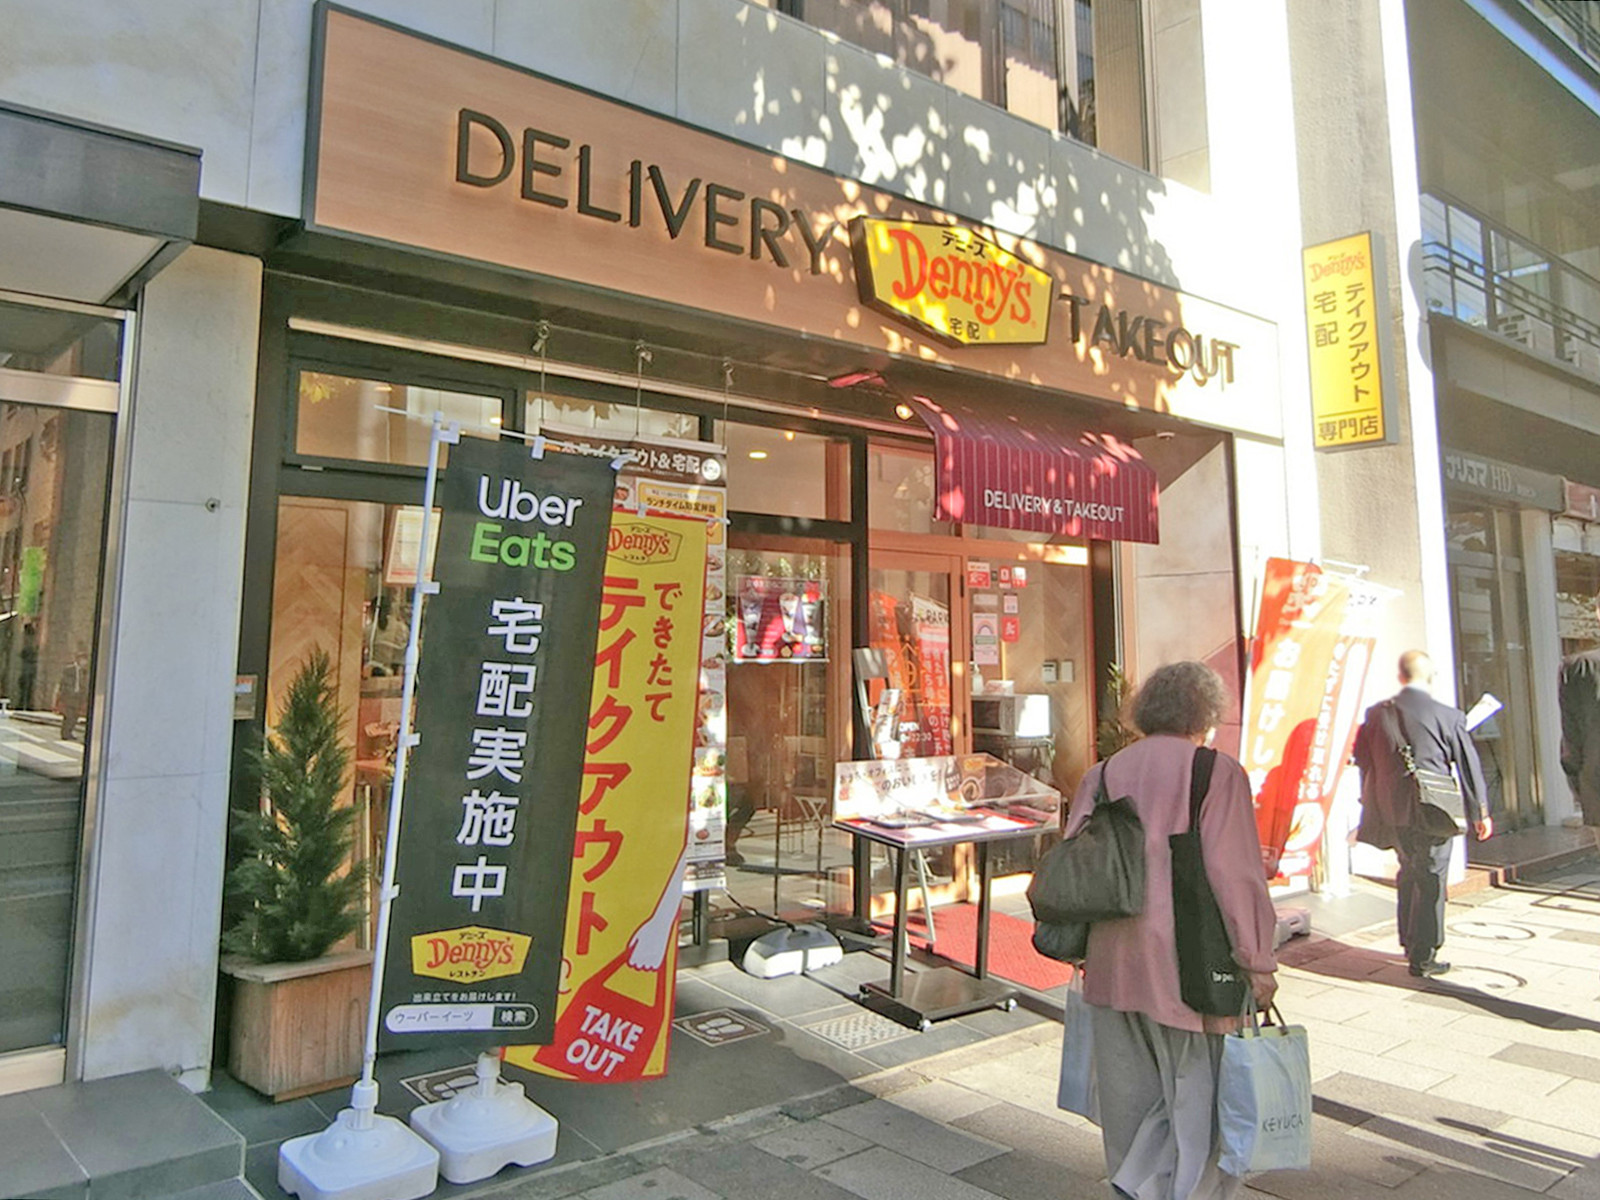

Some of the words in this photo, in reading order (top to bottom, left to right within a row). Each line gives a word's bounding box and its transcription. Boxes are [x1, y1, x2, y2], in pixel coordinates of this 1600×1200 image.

[456, 108, 838, 275] DELIVERY
[942, 230, 988, 259] デニーズ
[1309, 252, 1366, 283] Denny's
[888, 228, 1032, 325] Denny's
[949, 317, 981, 341] 宅配
[1057, 293, 1241, 385] TAKEOUT
[1313, 290, 1340, 348] 宅配
[1345, 282, 1371, 403] テイクアウト
[1318, 415, 1379, 441] 専門店
[478, 474, 583, 527] Uber
[984, 488, 1053, 514] DELIVERY
[1053, 499, 1063, 515] &
[1064, 499, 1124, 523] TAKEOUT
[470, 522, 576, 571] Eats
[606, 527, 670, 557] Denny's
[645, 582, 683, 722] できたて
[452, 597, 543, 913] 宅配実施中
[573, 576, 646, 957] テイクアウト
[426, 936, 514, 969] Denny's
[395, 1011, 474, 1023] ウーバーイーツ
[501, 1010, 528, 1023] 検索
[580, 1005, 644, 1052] TAKE
[566, 1038, 625, 1078] OUT
[1261, 1114, 1304, 1133] KEYUCA
